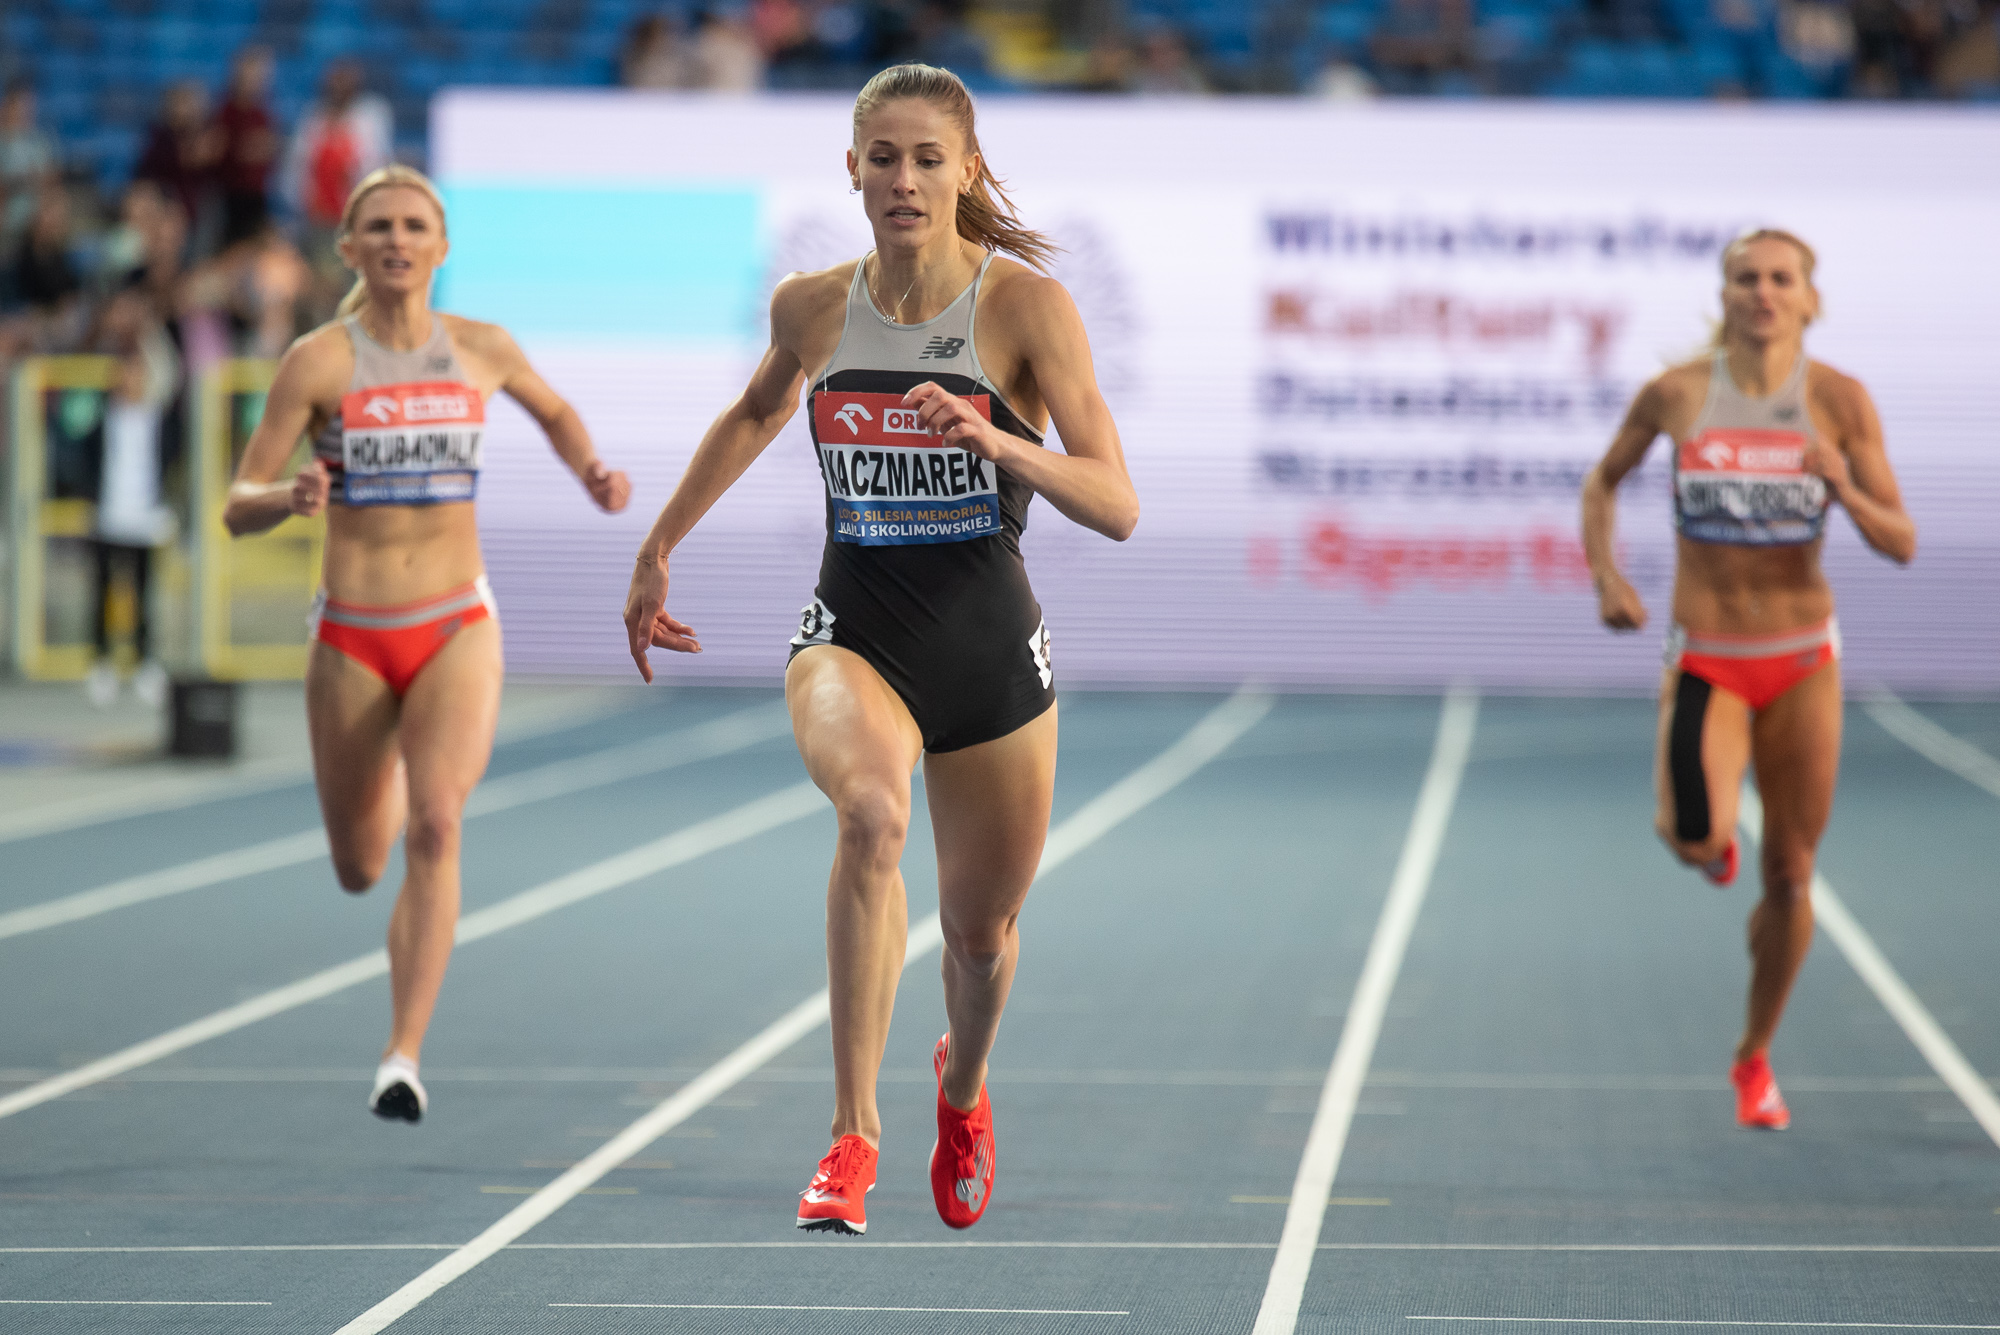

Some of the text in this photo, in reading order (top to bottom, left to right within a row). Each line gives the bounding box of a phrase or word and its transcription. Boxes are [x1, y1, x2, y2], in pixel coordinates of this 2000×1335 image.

[823, 449, 989, 496] KACZMAREK
[864, 510, 914, 522] SILESIA
[917, 503, 991, 521] MEMORIAŁ
[869, 515, 992, 537] SKOLIMOWSKIEJ
